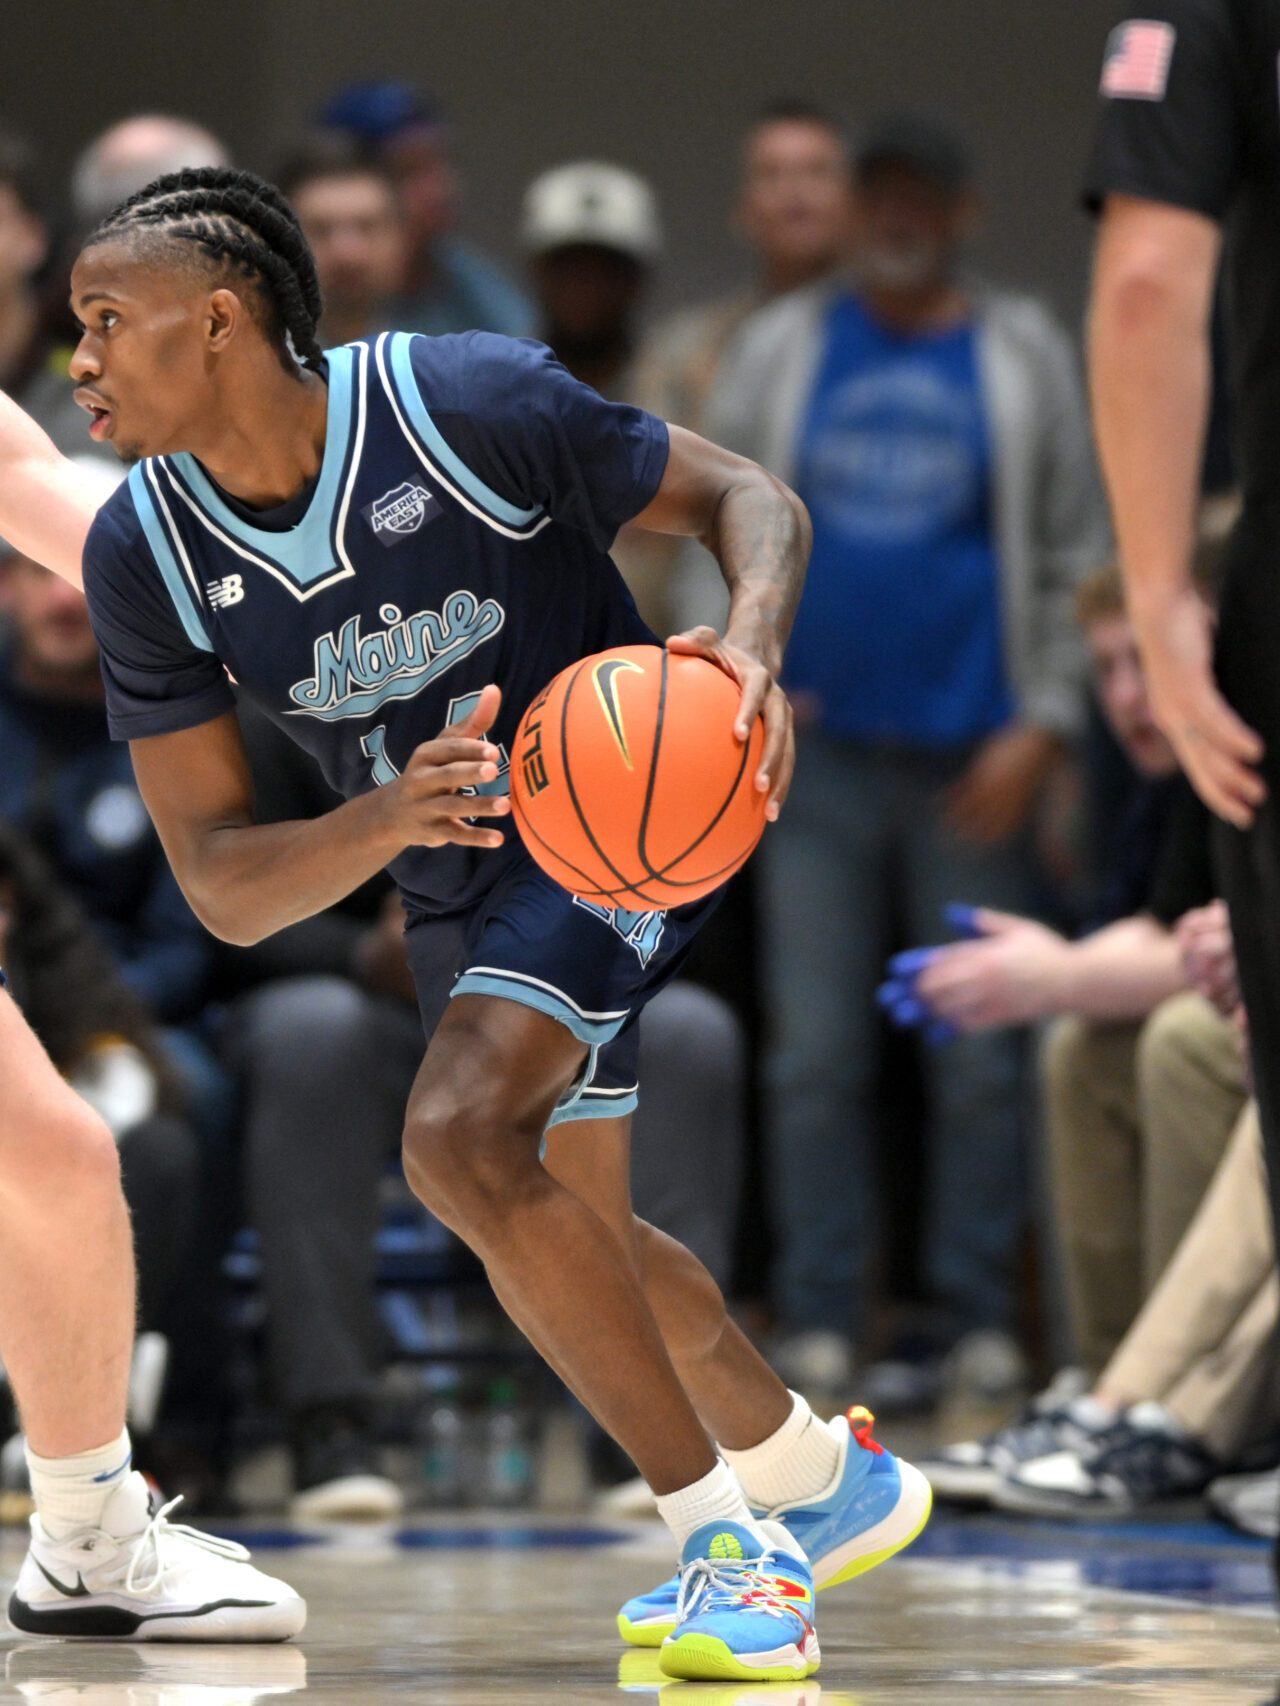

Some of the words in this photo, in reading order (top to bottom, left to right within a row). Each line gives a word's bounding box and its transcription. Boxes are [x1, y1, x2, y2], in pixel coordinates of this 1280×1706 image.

[373, 489, 429, 528] AMERICA
[389, 503, 419, 528] EAST
[283, 590, 505, 716] Maine
